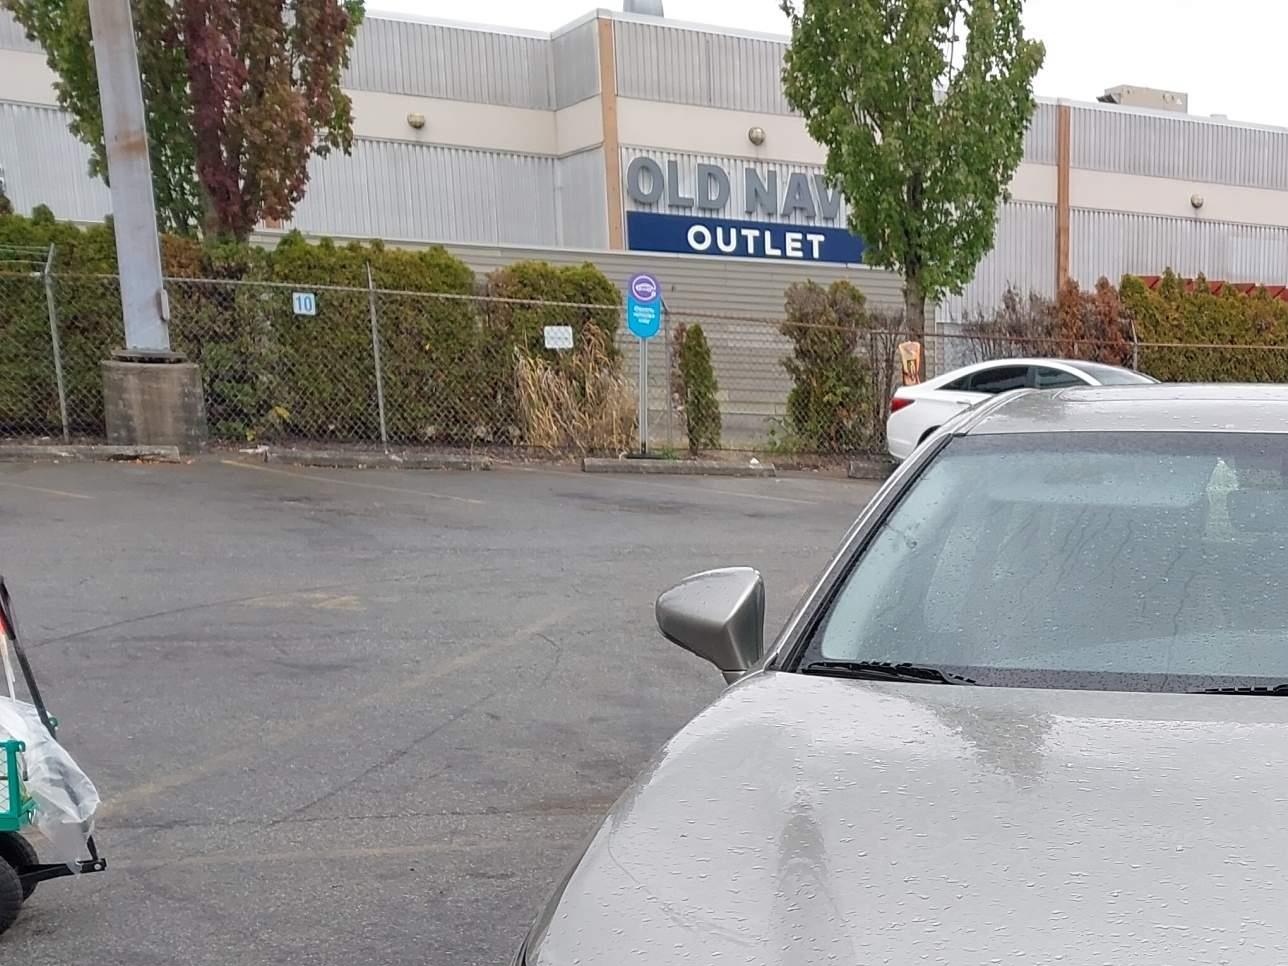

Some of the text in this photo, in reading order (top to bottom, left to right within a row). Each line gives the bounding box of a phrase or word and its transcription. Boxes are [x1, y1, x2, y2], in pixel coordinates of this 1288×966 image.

[627, 156, 846, 219] OLD NAV
[687, 225, 825, 259] OUTLET
[296, 295, 312, 312] 10
